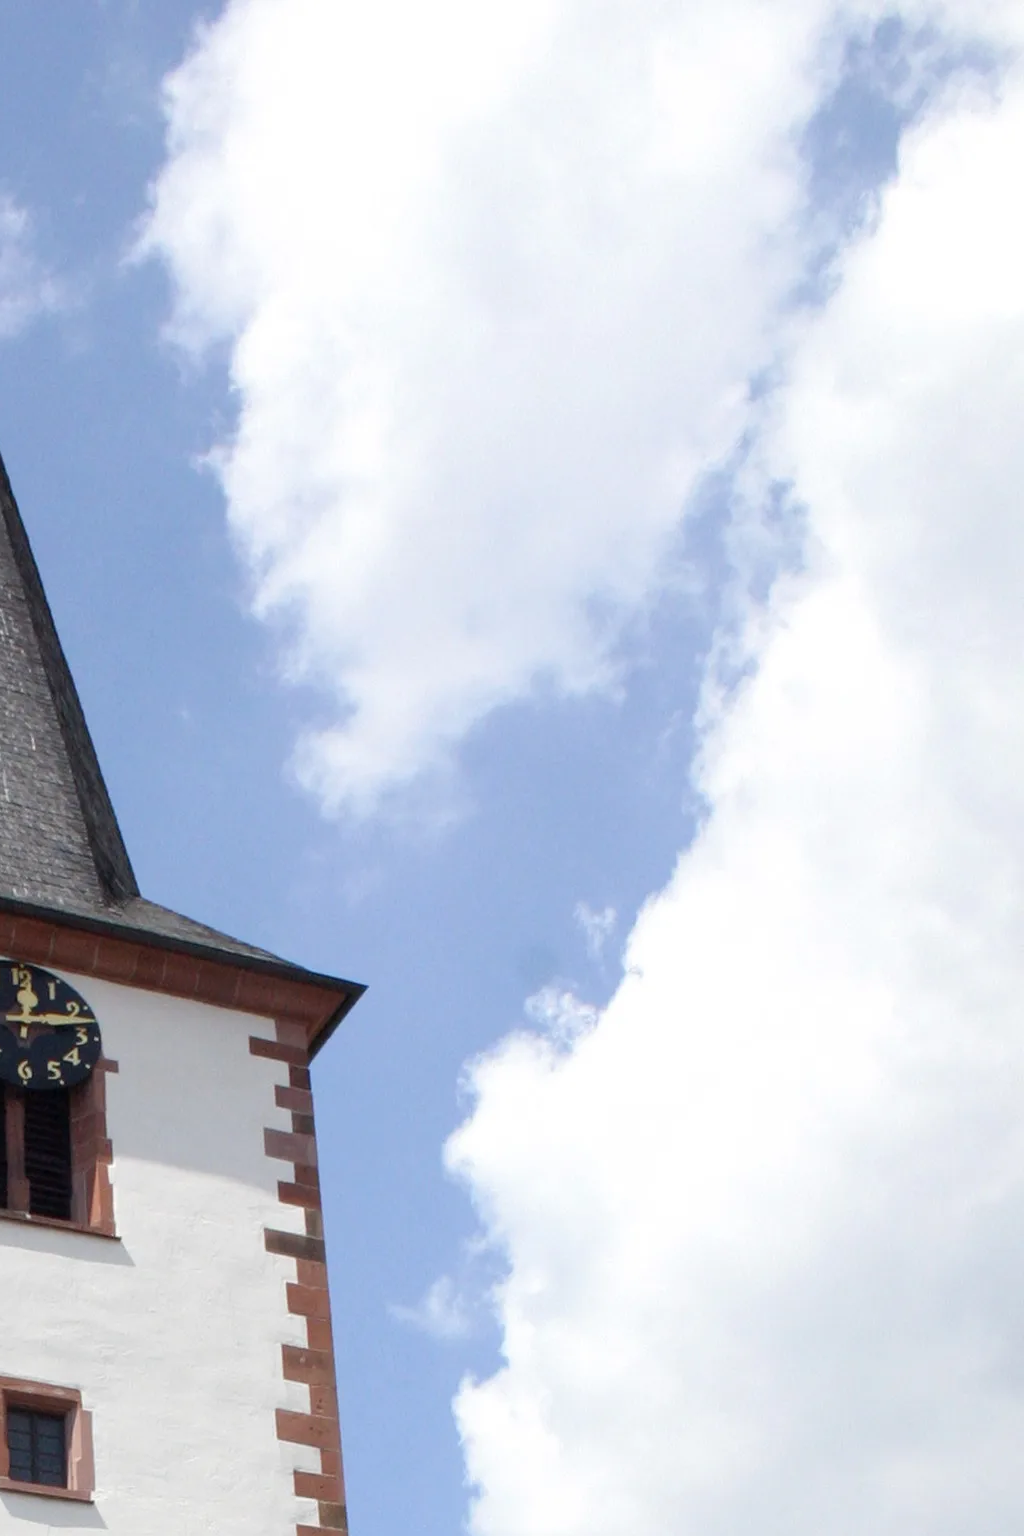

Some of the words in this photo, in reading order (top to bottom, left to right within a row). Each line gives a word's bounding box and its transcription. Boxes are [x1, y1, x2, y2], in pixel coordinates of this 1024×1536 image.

[11, 968, 31, 987] 12
[49, 983, 55, 1000] 1
[66, 1001, 79, 1018] 2
[76, 1027, 88, 1045] 3
[63, 1048, 81, 1066] 4
[18, 1060, 32, 1079] 6
[47, 1062, 61, 1080] 5
